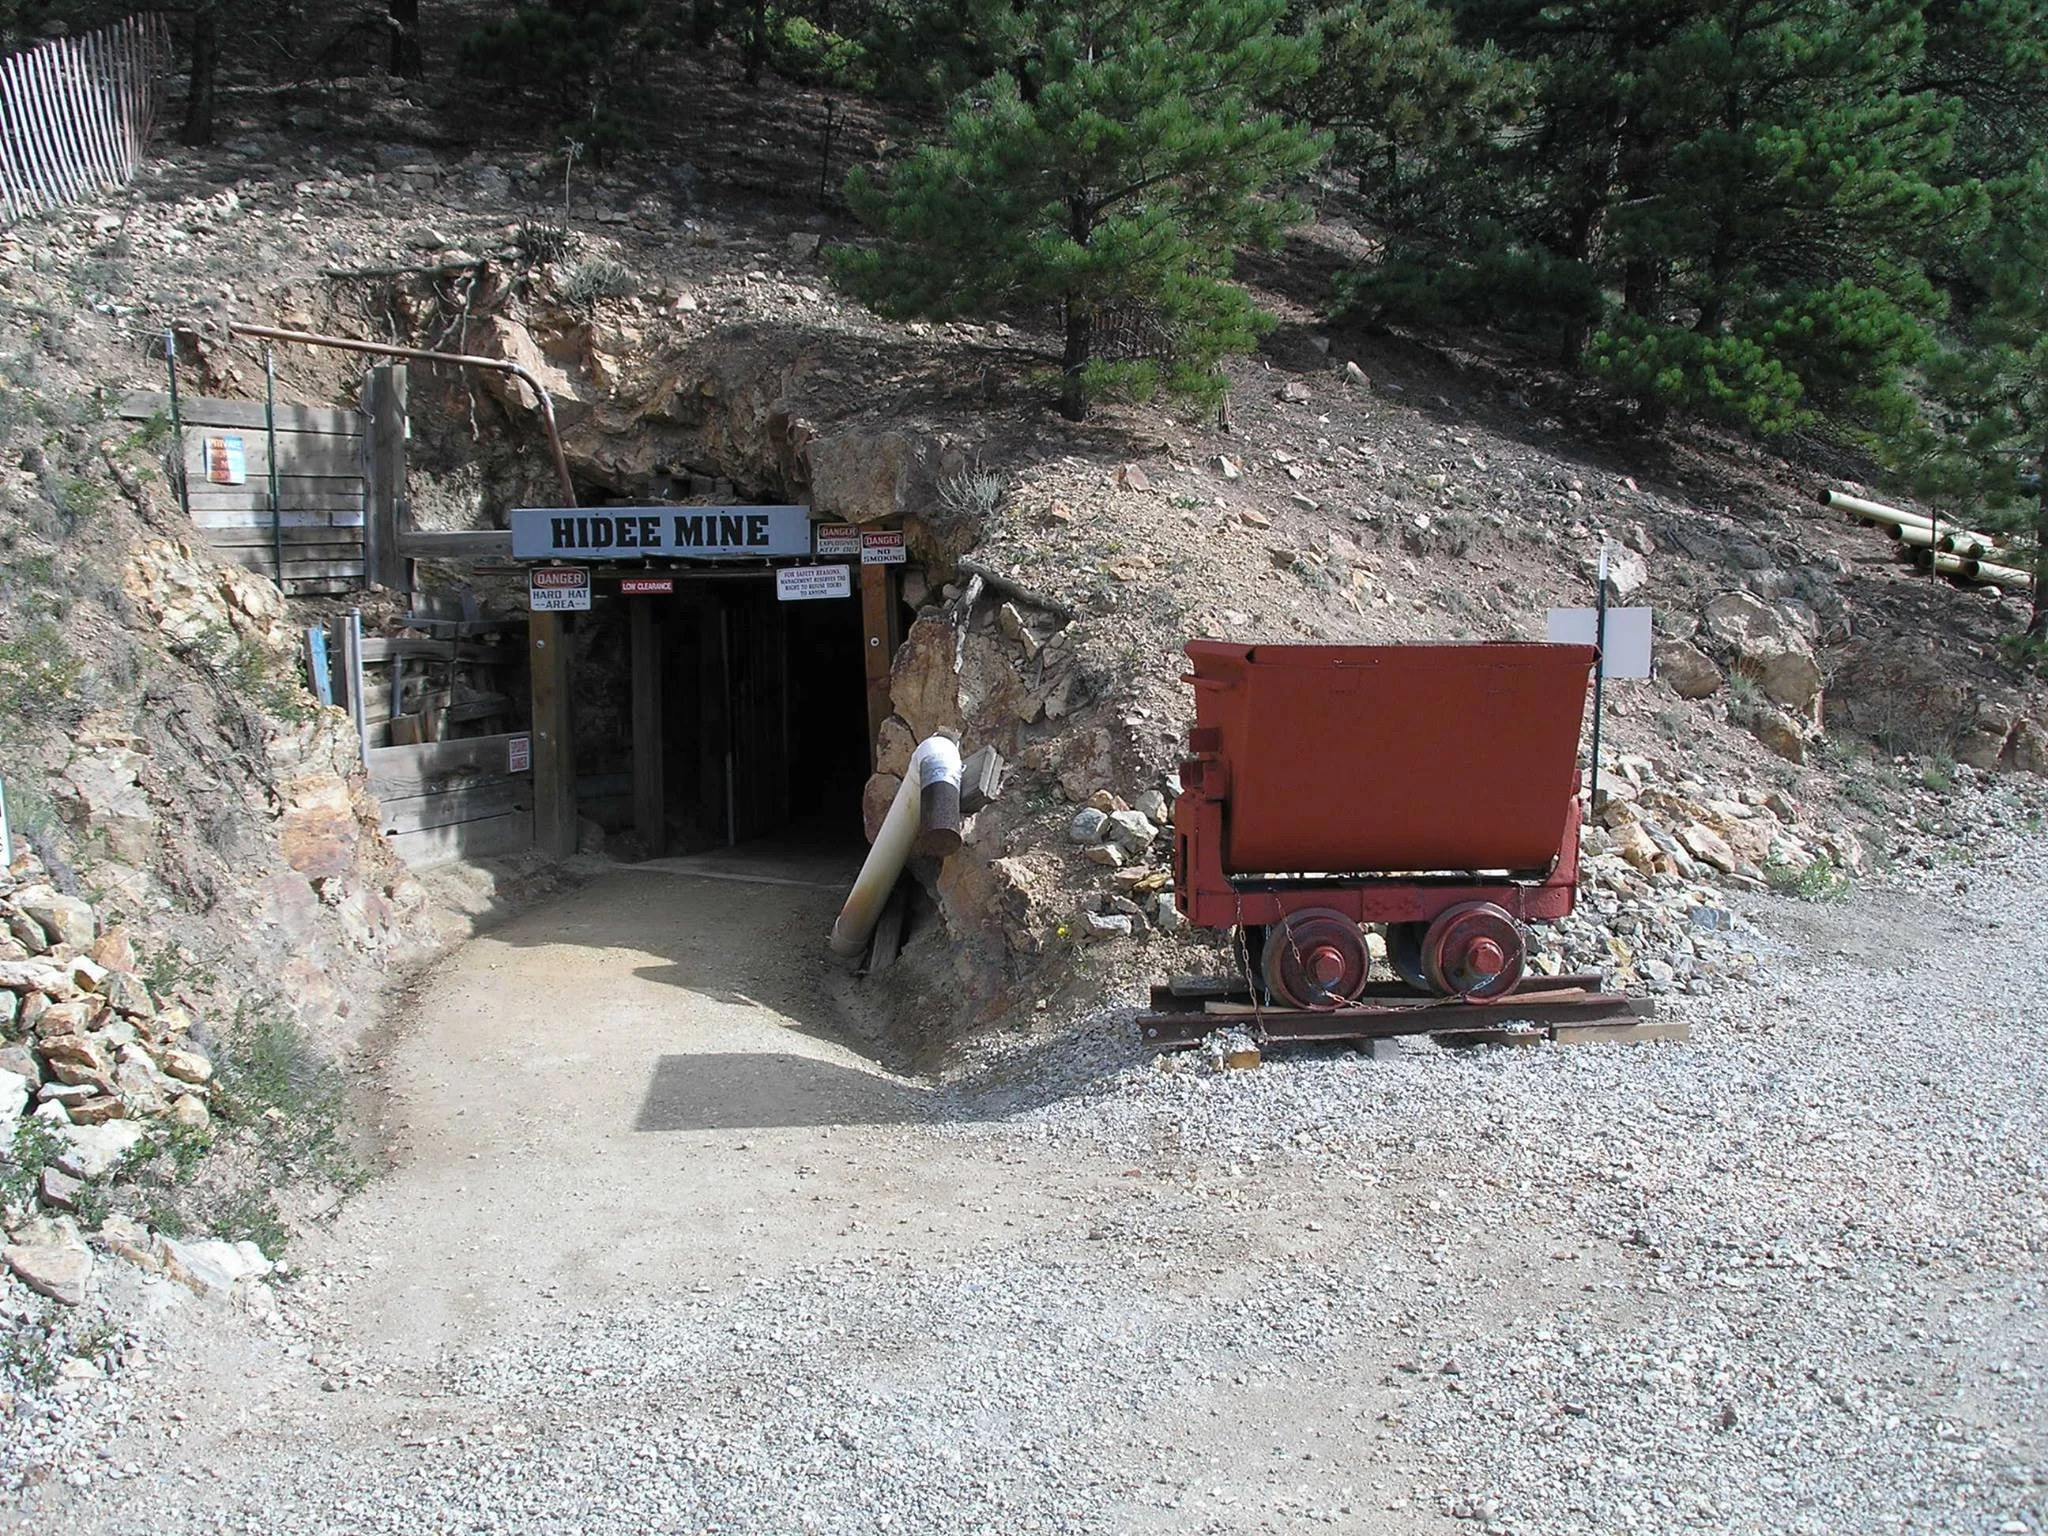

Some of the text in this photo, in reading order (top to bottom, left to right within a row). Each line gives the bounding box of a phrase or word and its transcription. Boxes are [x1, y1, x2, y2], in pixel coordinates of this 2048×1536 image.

[551, 514, 769, 548] HIDEE MINE
[822, 527, 857, 536] DANGER
[866, 536, 900, 545] DANGER
[537, 572, 582, 585] DANGER
[780, 576, 812, 584] MANAGEMENT
[622, 582, 672, 591] LOW CLEARANCE
[533, 589, 588, 600] HARD HAT
[545, 599, 575, 609] AREA
